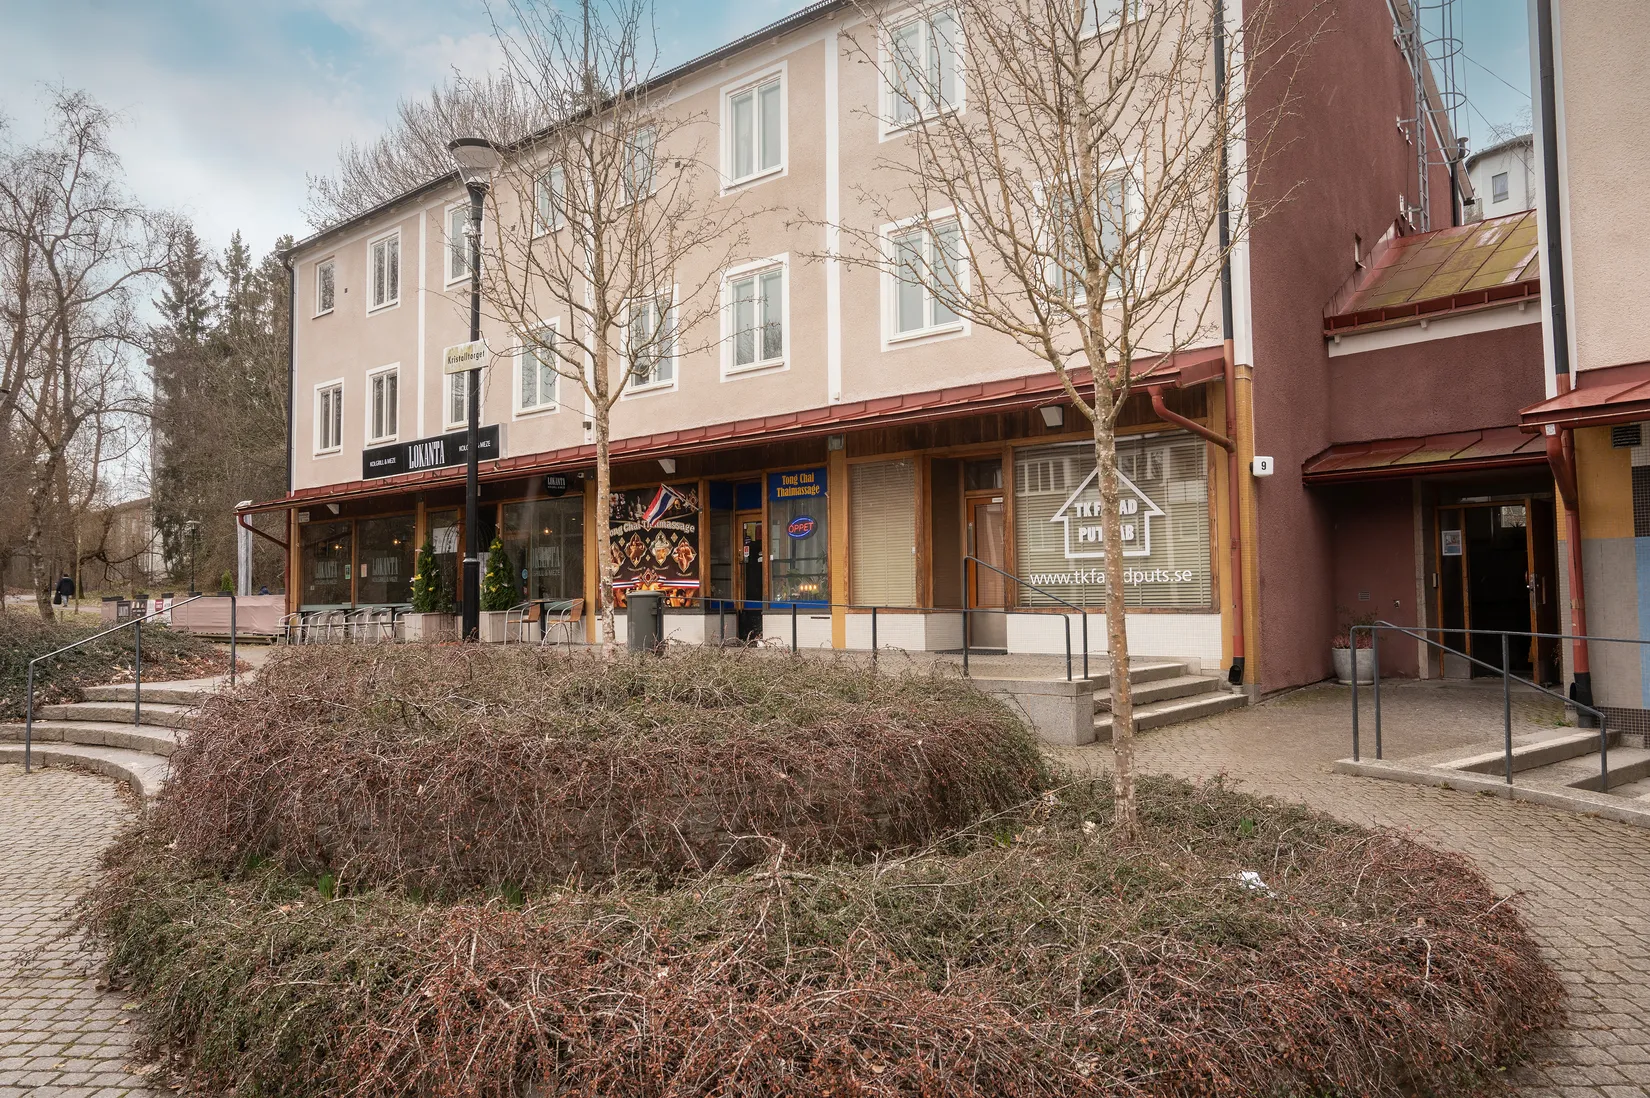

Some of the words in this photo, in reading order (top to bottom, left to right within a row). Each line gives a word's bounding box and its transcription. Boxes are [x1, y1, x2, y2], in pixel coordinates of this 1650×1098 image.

[447, 350, 485, 364] Kristalltorget
[408, 440, 445, 469] LOKANTA
[1261, 461, 1267, 470] 9
[548, 477, 565, 486] LOKANTA
[782, 474, 798, 485] Tong
[800, 472, 814, 483] Chai
[776, 484, 820, 497] Thaimassage
[1093, 499, 1138, 516] FAD
[609, 525, 624, 537] ong
[1078, 526, 1104, 543] PUT
[372, 557, 399, 575] LOKANTA
[1029, 567, 1192, 587] www.tkfadputs.se
